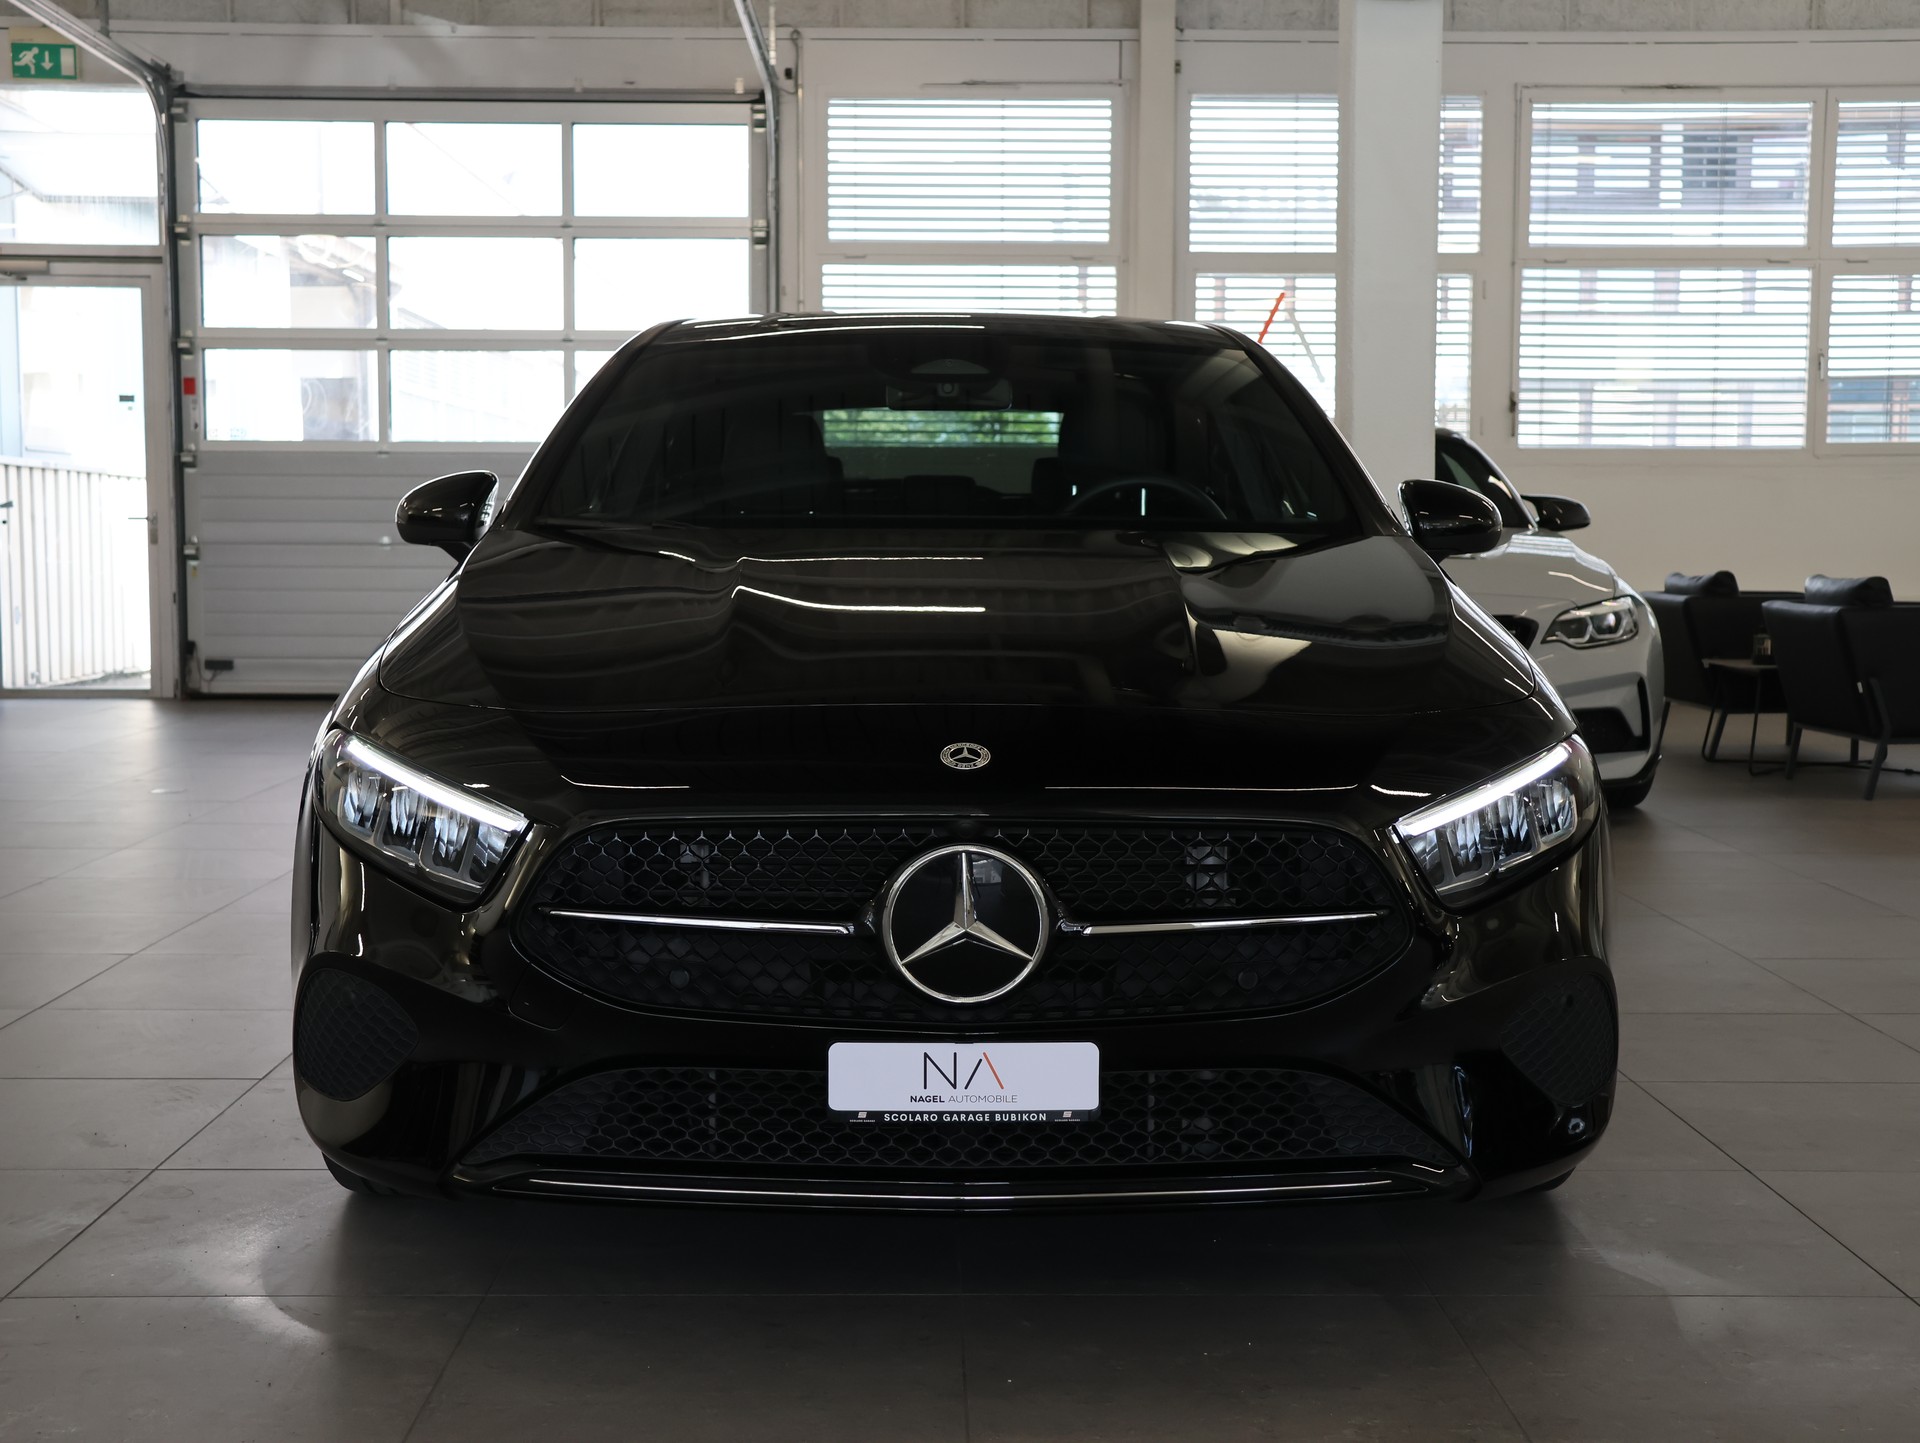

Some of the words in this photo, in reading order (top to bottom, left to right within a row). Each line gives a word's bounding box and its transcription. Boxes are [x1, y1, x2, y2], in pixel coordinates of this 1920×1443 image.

[910, 1095, 945, 1103] NAGEL
[948, 1095, 1018, 1103] AUTOMOBILE
[884, 1113, 938, 1122] SCOLARO
[942, 1113, 990, 1122] GARAGE
[995, 1112, 1047, 1122] BUBIKON
